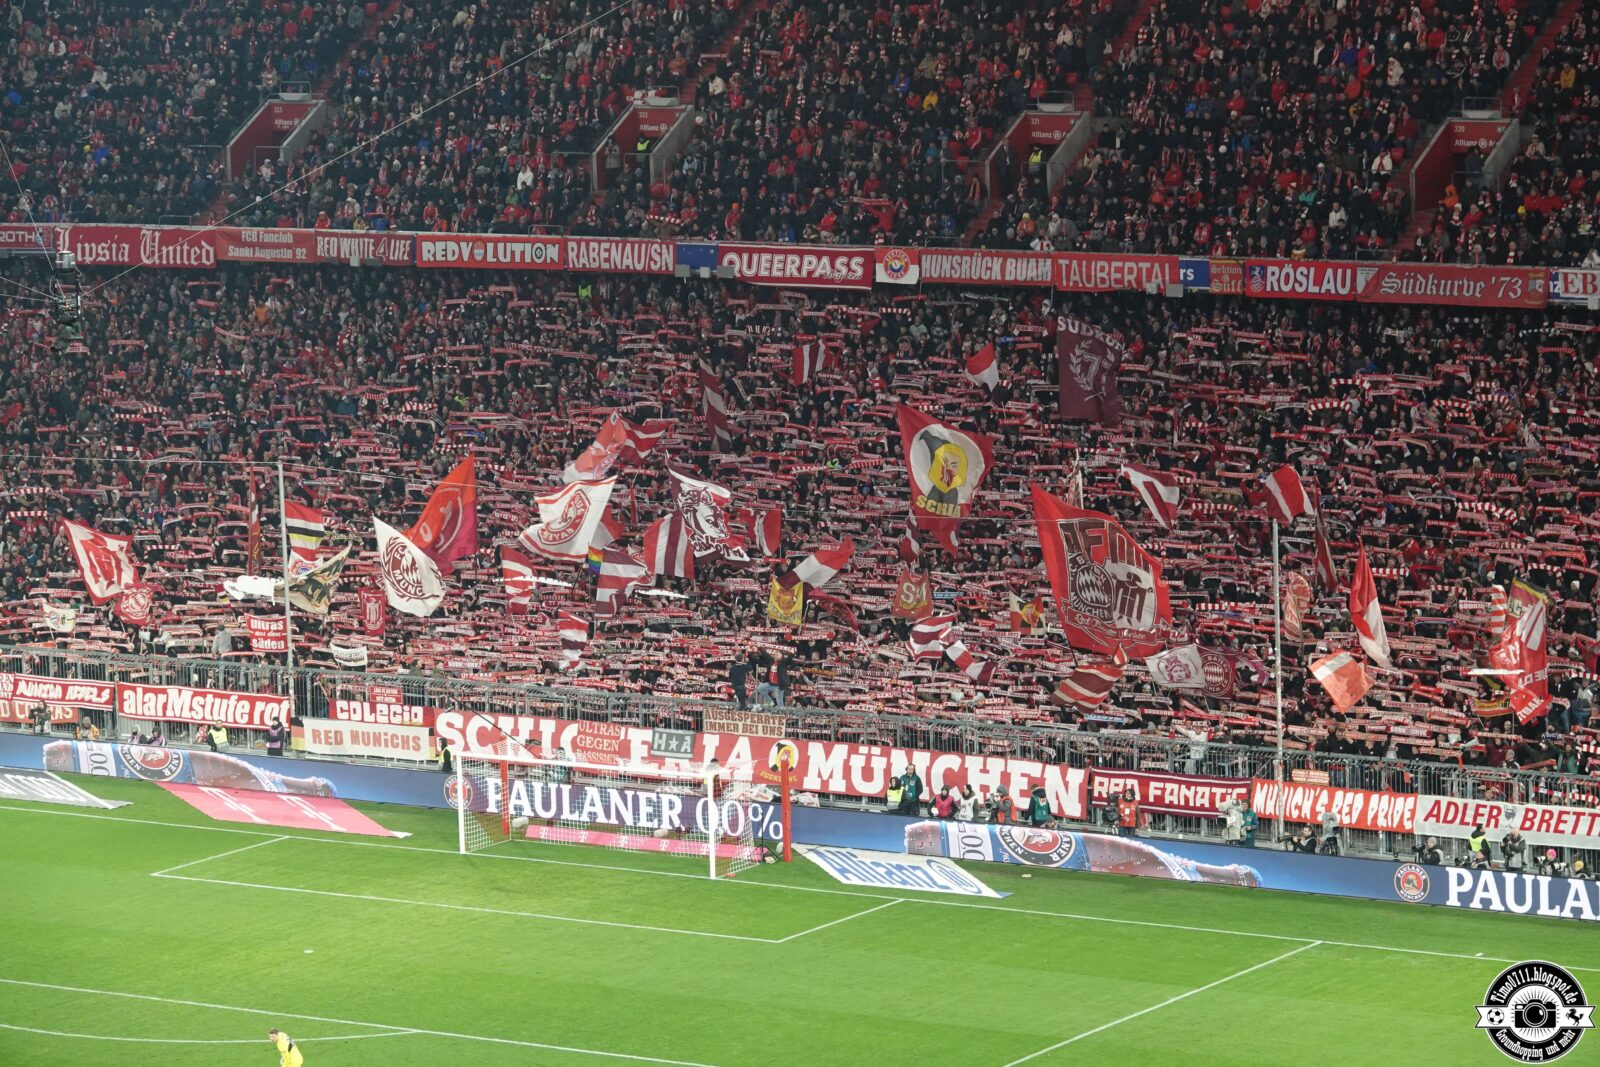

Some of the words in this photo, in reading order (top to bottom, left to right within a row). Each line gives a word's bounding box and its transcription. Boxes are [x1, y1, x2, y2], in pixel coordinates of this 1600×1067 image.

[140, 229, 215, 266] United
[259, 231, 293, 244] Fanclub
[339, 237, 375, 260] WHITE
[389, 239, 412, 261] LIFE
[228, 245, 253, 259] Sankt
[722, 252, 865, 279] QUEERPASS
[921, 252, 1004, 281] HUNSRÜCK
[1005, 257, 1051, 282] BUAM
[1058, 258, 1172, 289] TAUBERTAL
[1266, 263, 1352, 295] RÖSLAU
[1380, 271, 1485, 298] Südkurve
[122, 687, 250, 723] alarMstufe
[253, 699, 290, 729] rot
[704, 709, 786, 725] AUSGESPERRTE
[311, 728, 344, 746] RED
[578, 719, 621, 738] ULTRAS
[704, 720, 739, 734] IMMER
[741, 723, 760, 735] BEI
[762, 724, 784, 737] UNS
[577, 734, 620, 752] GEGEN
[803, 741, 1090, 818] MÜNCHEN
[486, 776, 684, 832] PAULANER
[1367, 793, 1415, 831] PRIDE
[1423, 799, 1501, 828] ADLER
[1396, 865, 1427, 880] PAULANER
[1400, 889, 1425, 902] MÜNCHEN
[1445, 866, 1600, 921] PAULA
